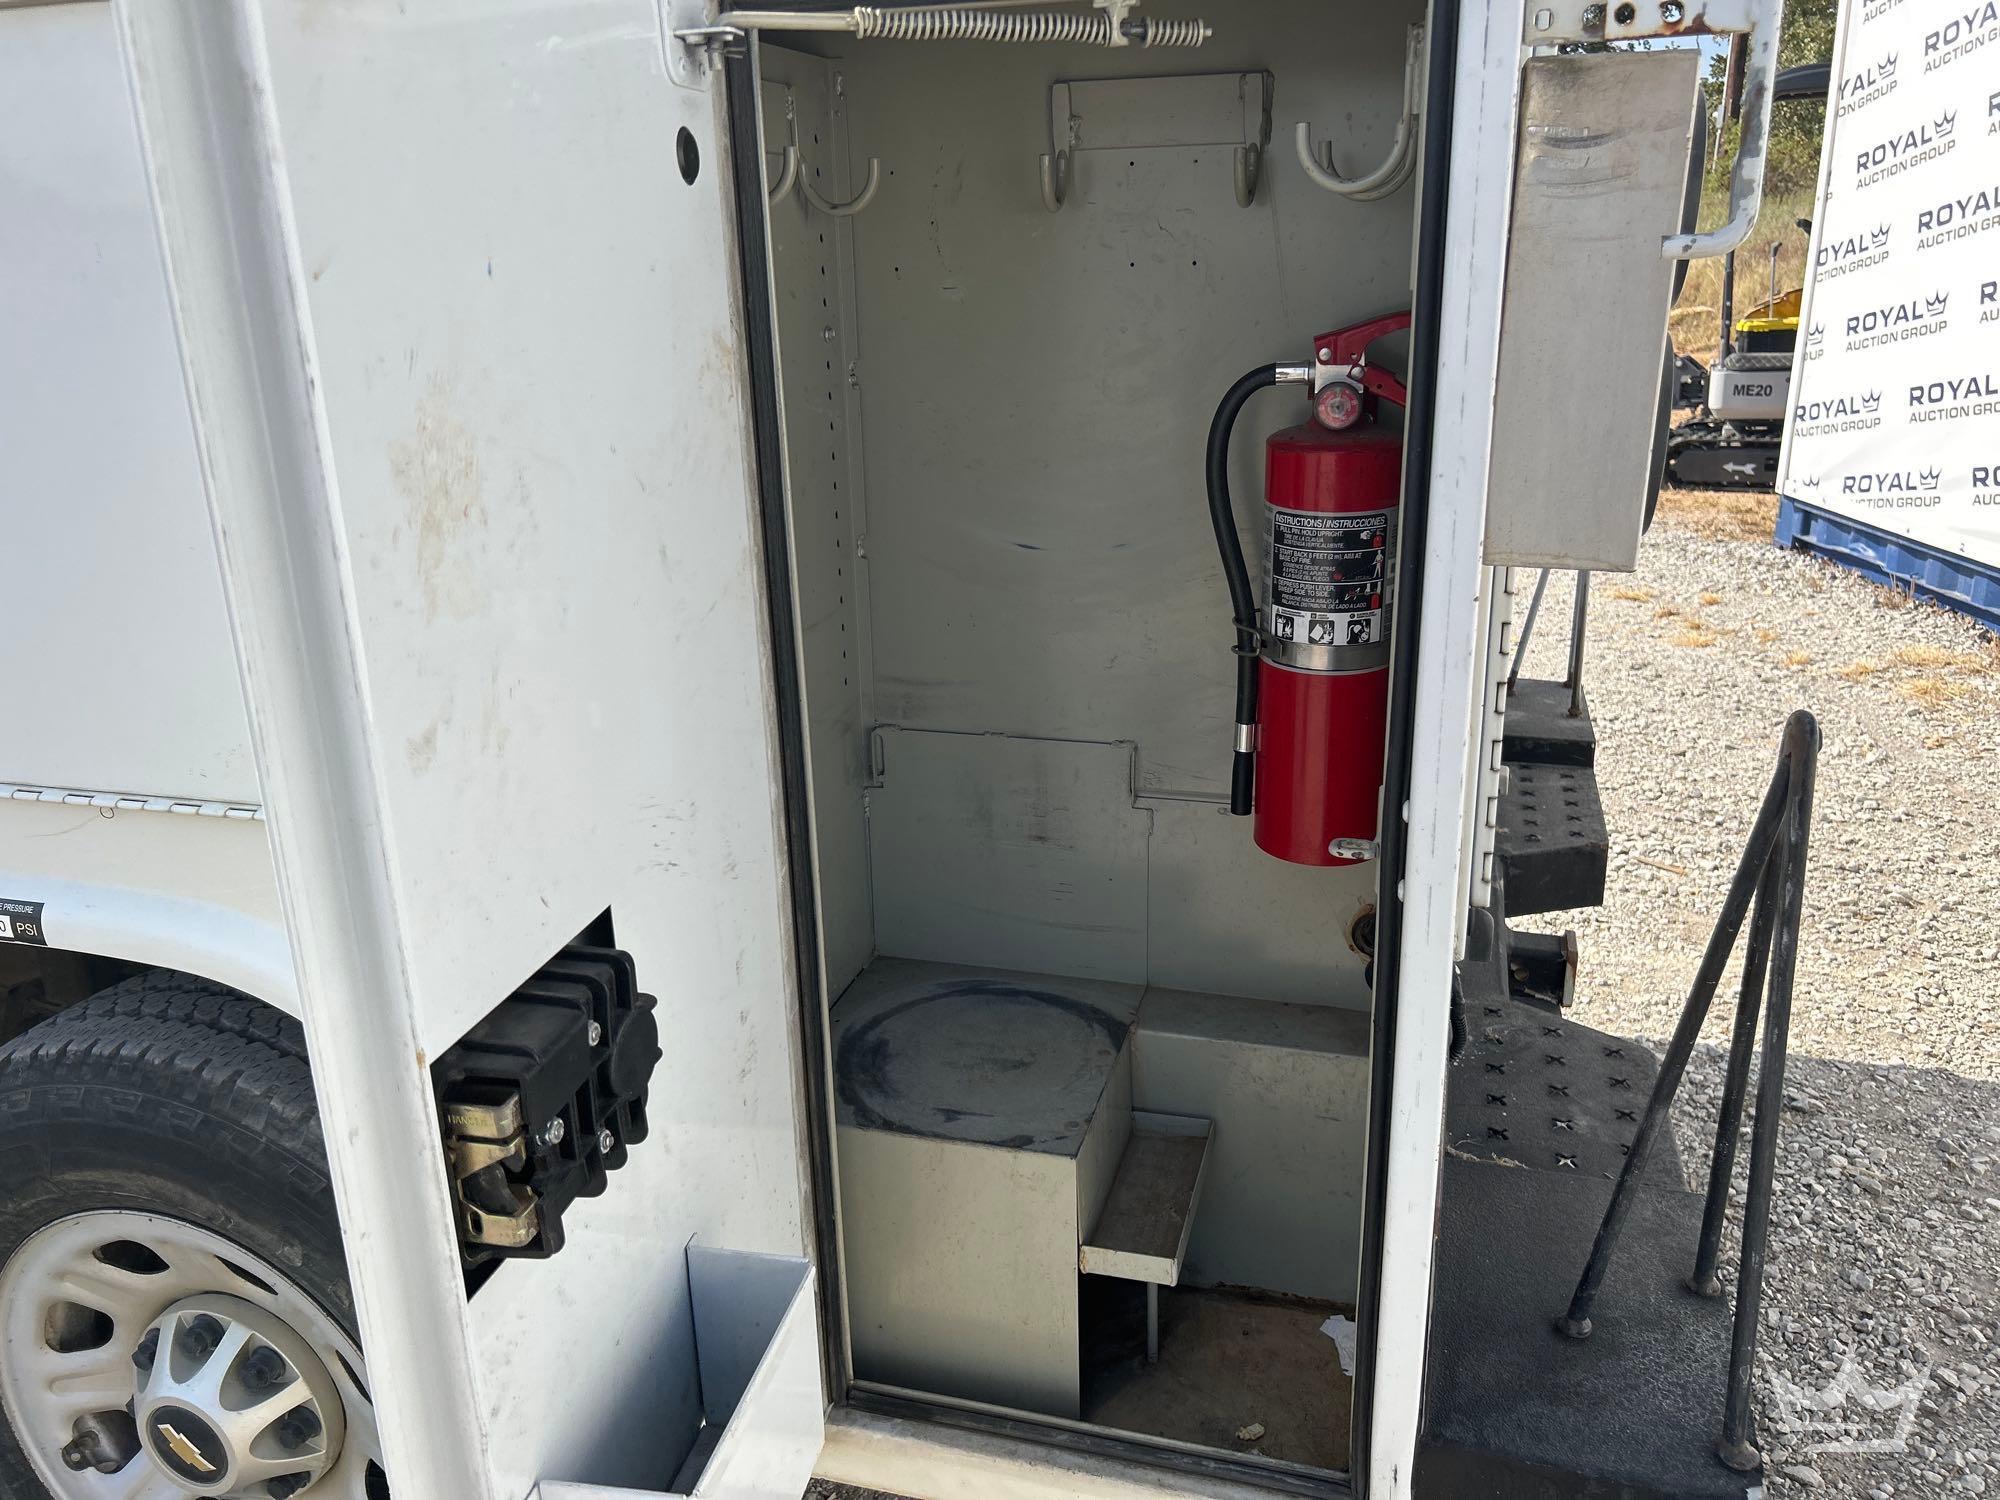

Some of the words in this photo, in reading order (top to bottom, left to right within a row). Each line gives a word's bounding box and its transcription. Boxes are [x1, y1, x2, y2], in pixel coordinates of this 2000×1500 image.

[1923, 33, 1985, 75] AUCTION
[1857, 79, 1897, 109] GROUP
[1857, 125, 1933, 174] ROYAL
[1856, 159, 1908, 191] AUCTION
[1910, 139, 1956, 168] GROUP
[1918, 186, 2000, 233] ROYAL
[1917, 221, 1978, 251] AUCTION
[1849, 250, 1889, 273] GROUP
[1846, 300, 1924, 337] ROYAL
[1845, 331, 1898, 353] AUCTION
[1900, 320, 1948, 341] GROUP
[1733, 384, 1773, 397] ME20
[1909, 374, 1999, 407] ROYAL
[1794, 396, 1861, 423] ROYAL
[1909, 405, 1970, 424] AUCTION
[1841, 417, 1881, 433] GROUP
[1843, 472, 1917, 494] ROYAL
[1896, 496, 1941, 509] GROUP
[3, 903, 35, 914] PRESSURE
[16, 922, 38, 936] PSI
